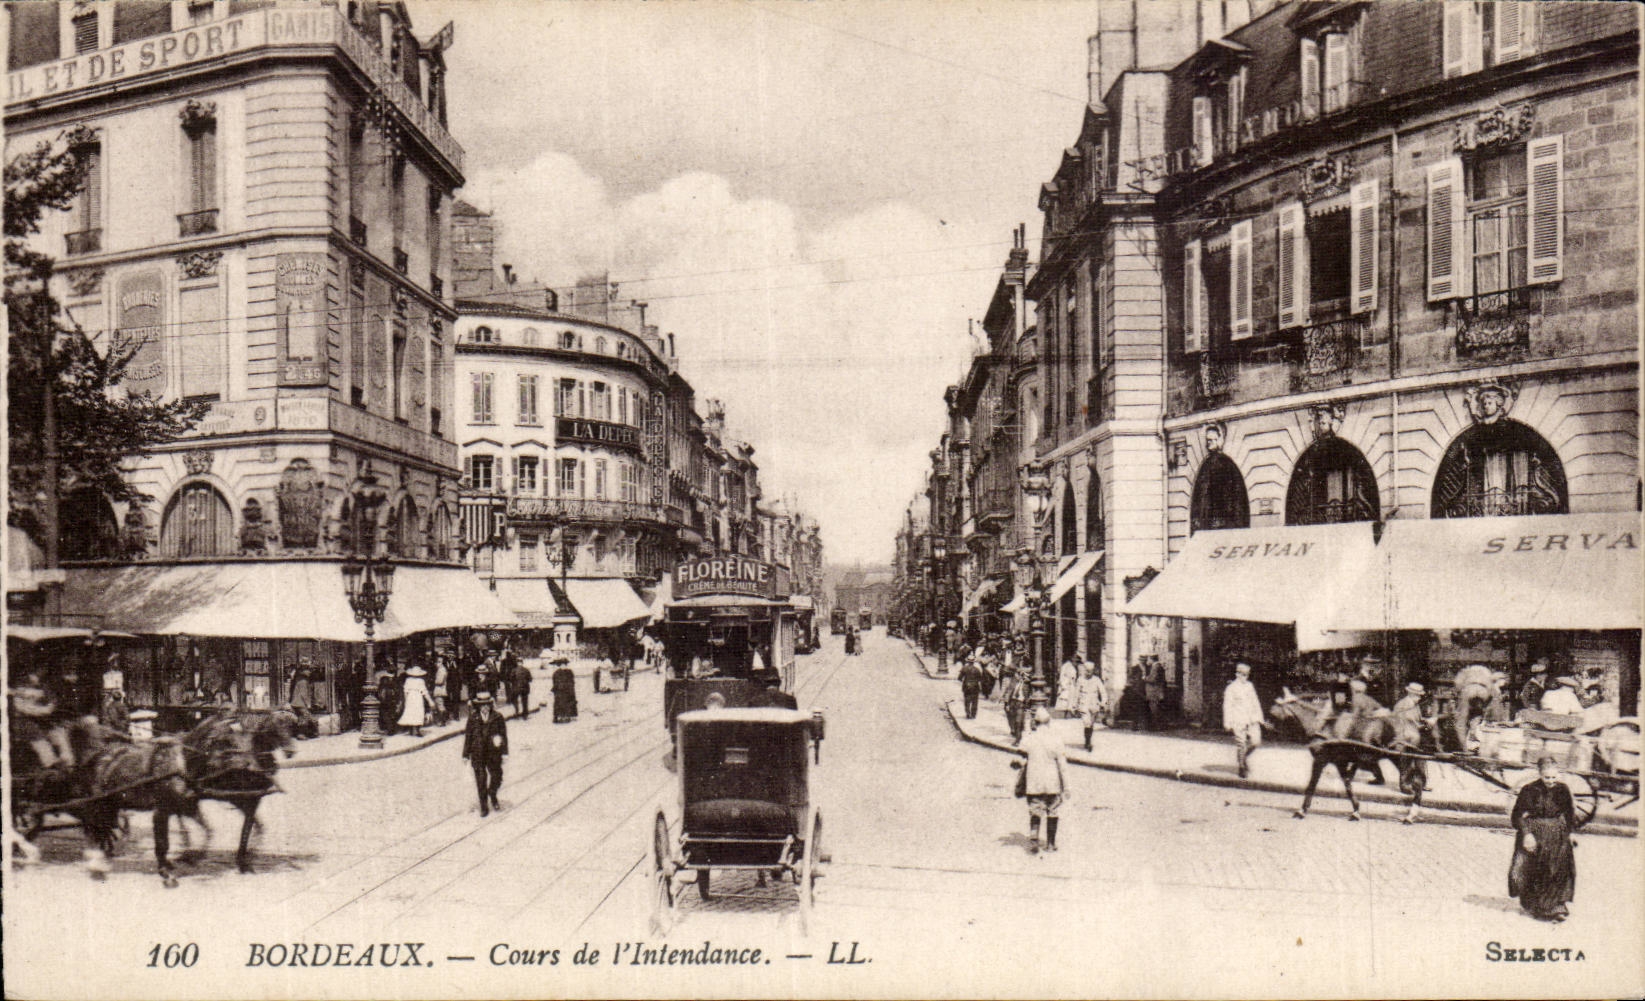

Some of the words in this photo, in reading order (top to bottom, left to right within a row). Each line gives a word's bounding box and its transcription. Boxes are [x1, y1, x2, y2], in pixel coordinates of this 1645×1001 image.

[43, 60, 78, 92] ET
[88, 48, 126, 84] DE
[139, 19, 244, 71] SPORT
[572, 421, 594, 440] LA
[1208, 542, 1316, 559] SERVAN
